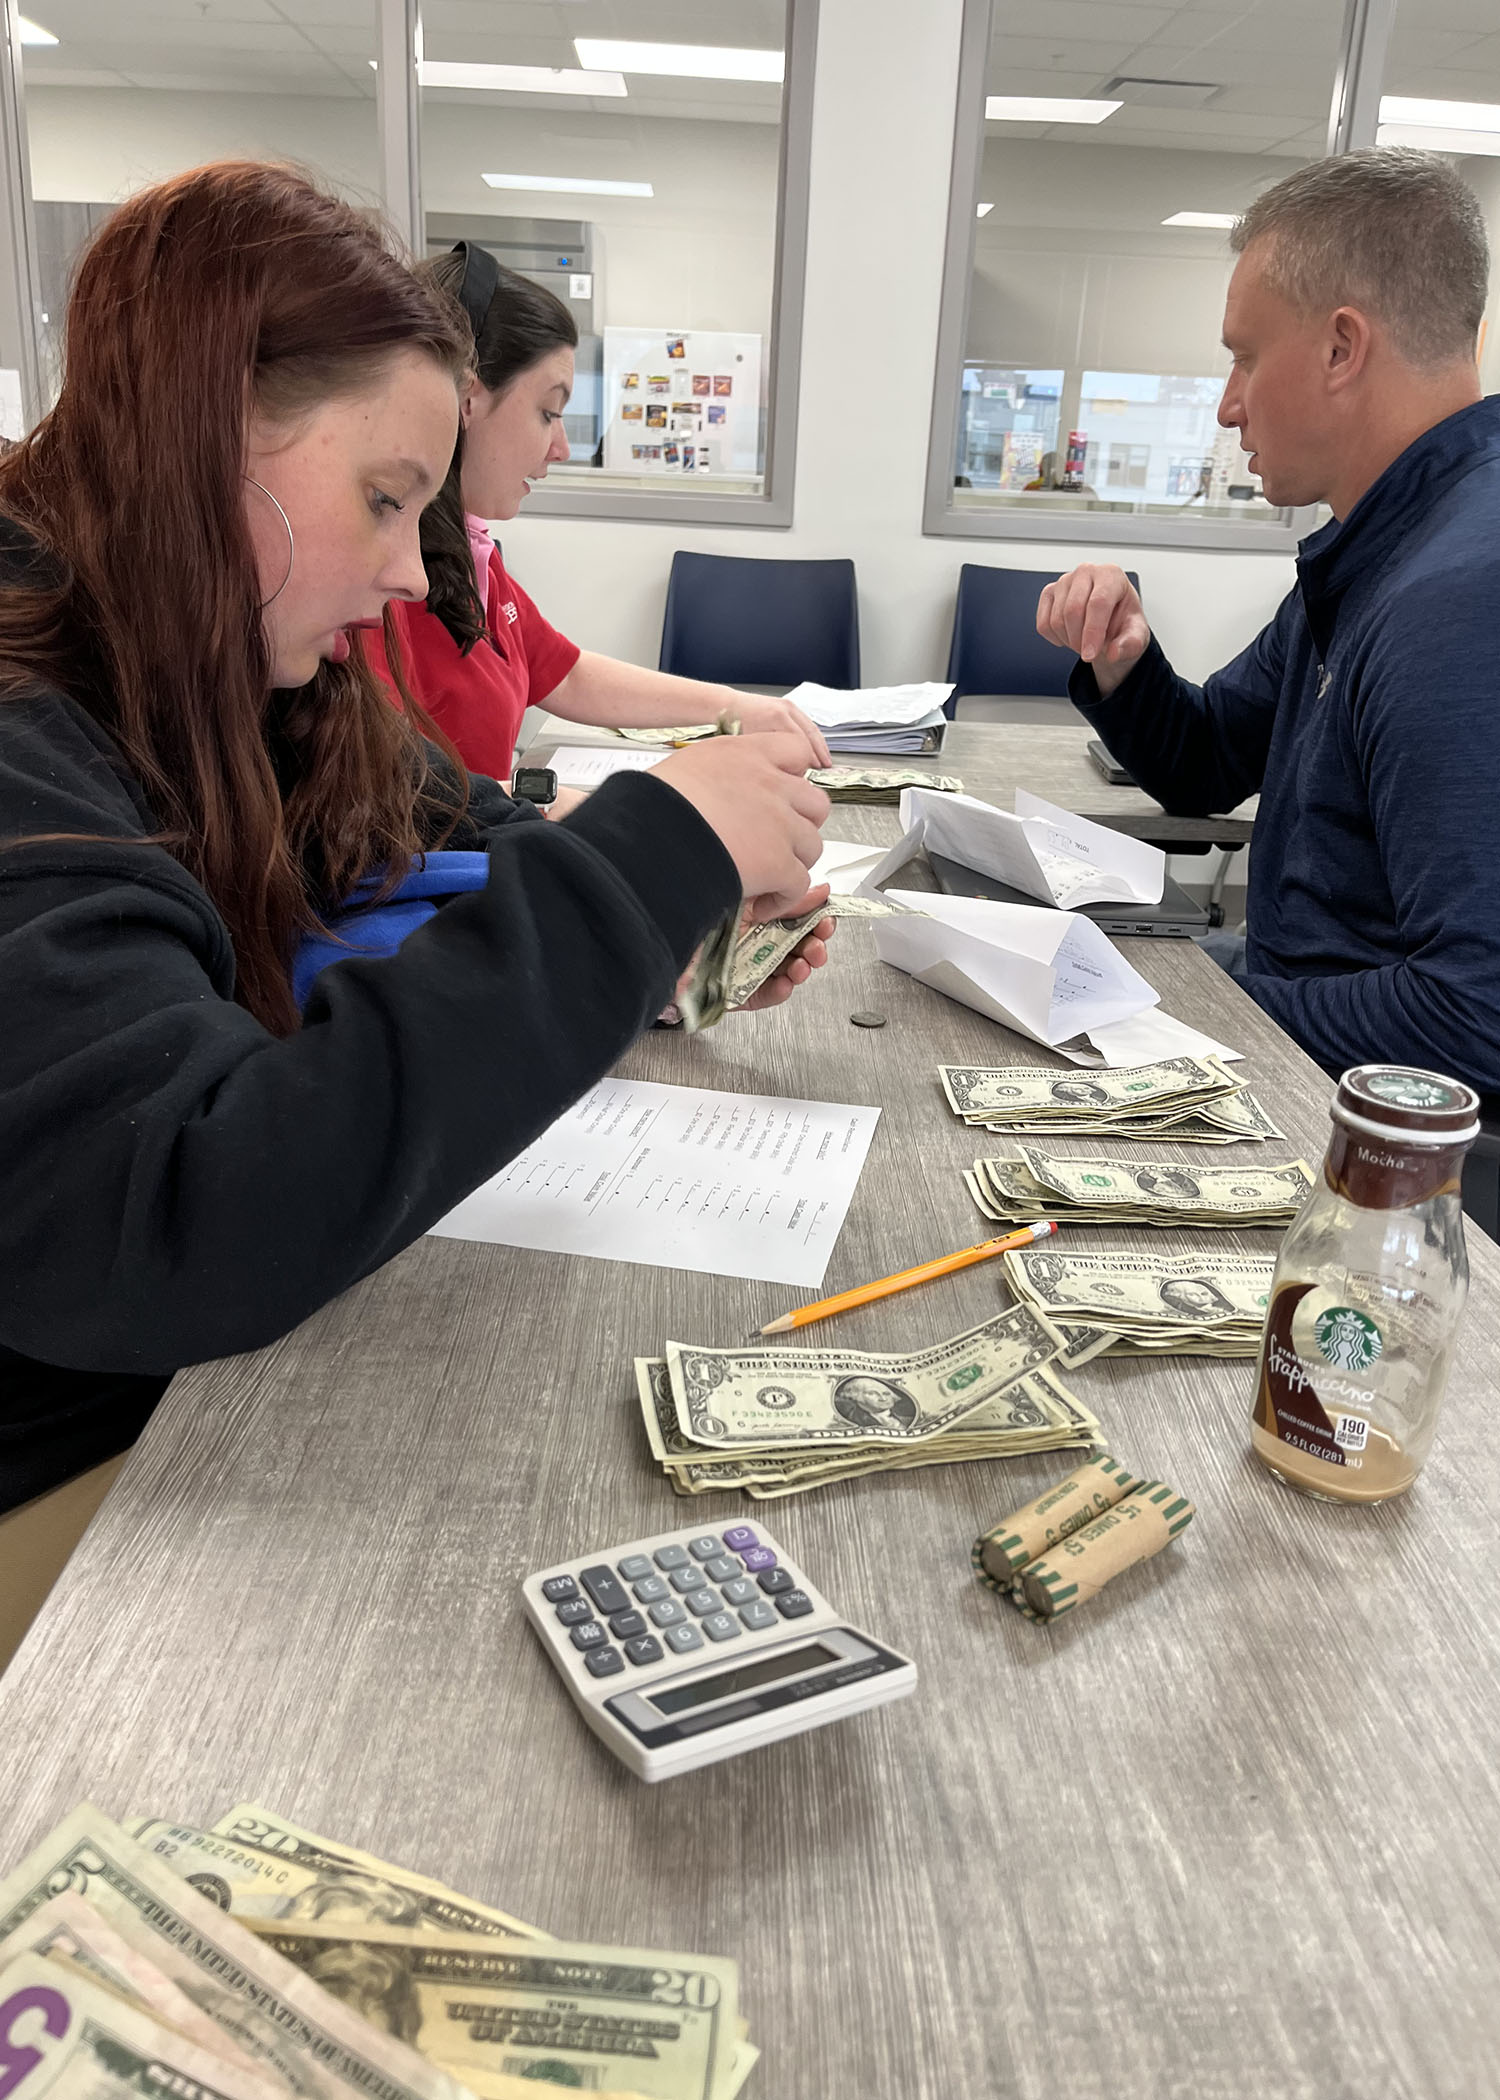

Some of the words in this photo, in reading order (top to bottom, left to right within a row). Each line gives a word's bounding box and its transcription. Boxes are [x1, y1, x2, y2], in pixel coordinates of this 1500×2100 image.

[1358, 1147, 1405, 1169] Mocha
[1070, 1260, 1099, 1269] THE
[1101, 1262, 1152, 1271] UNITED
[1226, 1264, 1275, 1273] AMERIC
[735, 1360, 771, 1369] THE
[772, 1361, 832, 1370] UNITED
[832, 1362, 891, 1374] STATES
[891, 1366, 914, 1374] OF
[913, 1338, 979, 1371] AMERICA
[1341, 1418, 1366, 1436] 190
[1285, 1431, 1299, 1447] 9.5
[1299, 1438, 1309, 1450] FL
[1309, 1443, 1321, 1457] OZ
[700, 1538, 713, 1550] 0
[718, 1559, 729, 1570] 1
[681, 1569, 696, 1581] 2
[644, 1580, 659, 1592] 3
[733, 1582, 746, 1594] 4
[698, 1592, 713, 1604] 5
[660, 1602, 674, 1616] 6
[754, 1605, 767, 1619] 7
[714, 1615, 730, 1629] 8
[677, 1627, 692, 1641] 9
[227, 1817, 301, 1854] 20
[423, 1953, 523, 1976] RESERVE
[553, 1964, 608, 1981] NOTE
[651, 1969, 721, 2012] 20
[178, 1927, 248, 1990] UNITED
[249, 1983, 313, 2044] STATES
[341, 2055, 404, 2100] AMERI
[508, 2026, 661, 2060] AMERICA
